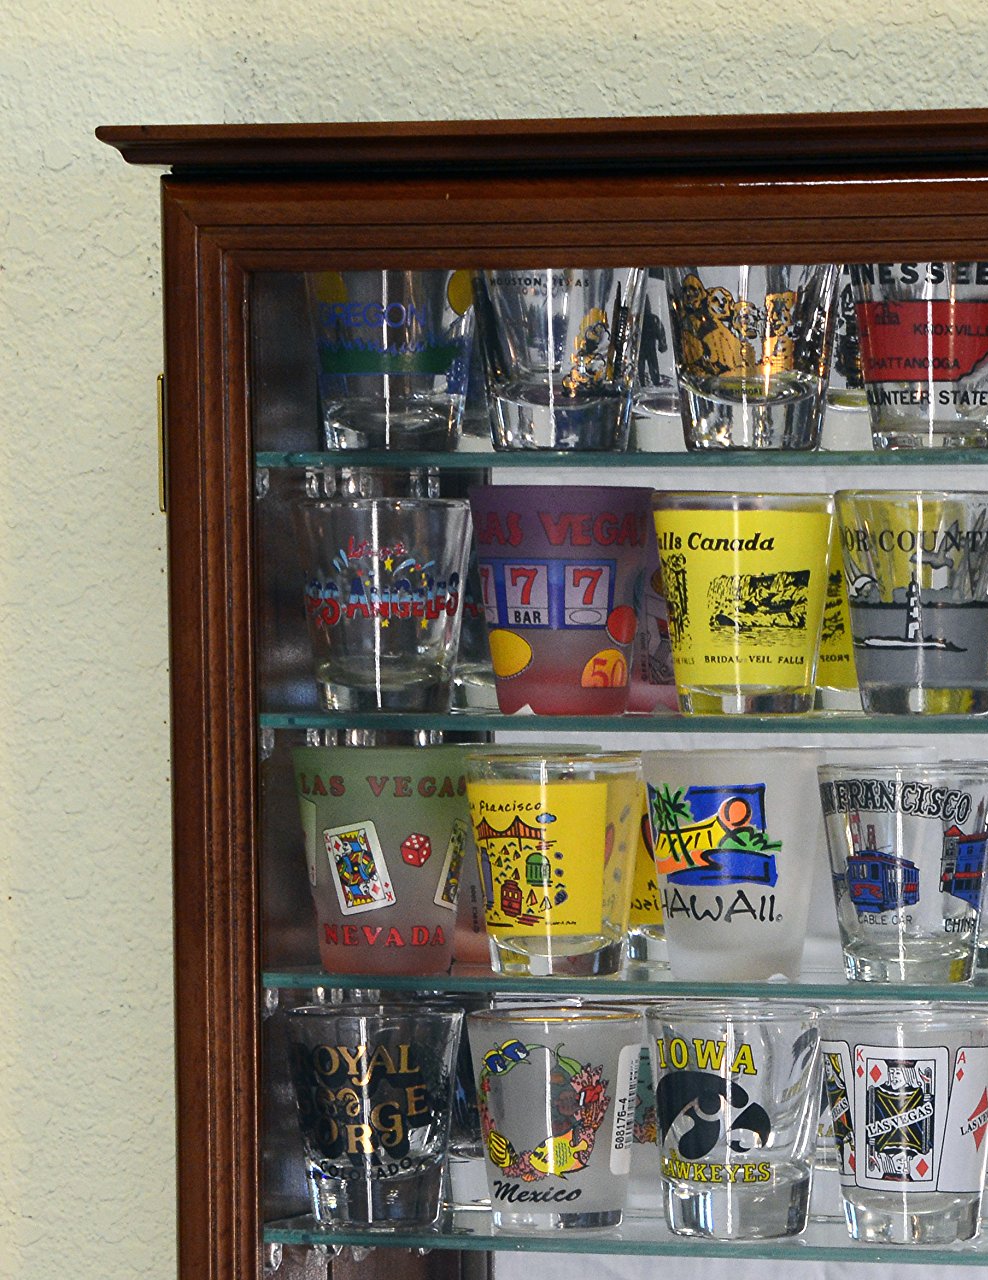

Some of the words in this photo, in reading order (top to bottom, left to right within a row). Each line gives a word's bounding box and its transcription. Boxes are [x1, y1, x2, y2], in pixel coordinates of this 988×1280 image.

[938, 390, 988, 406] STATE
[687, 532, 775, 552] Canada
[510, 568, 539, 606] 7
[574, 568, 604, 606] 7
[514, 610, 542, 625] BAR
[749, 655, 772, 666] VEIL
[778, 655, 805, 666] FALLS
[591, 658, 627, 688] 50
[301, 774, 346, 797] LAS
[366, 775, 468, 798] VEGAS
[834, 778, 972, 825] FRANCISCO
[857, 913, 887, 927] CABLE
[323, 924, 446, 947] NEVADA
[656, 1037, 757, 1076] IOWA
[856, 1049, 865, 1063] K
[614, 1096, 628, 1150] 608176-4
[893, 1103, 933, 1128] VEGAS
[493, 1180, 582, 1203] Mexico
